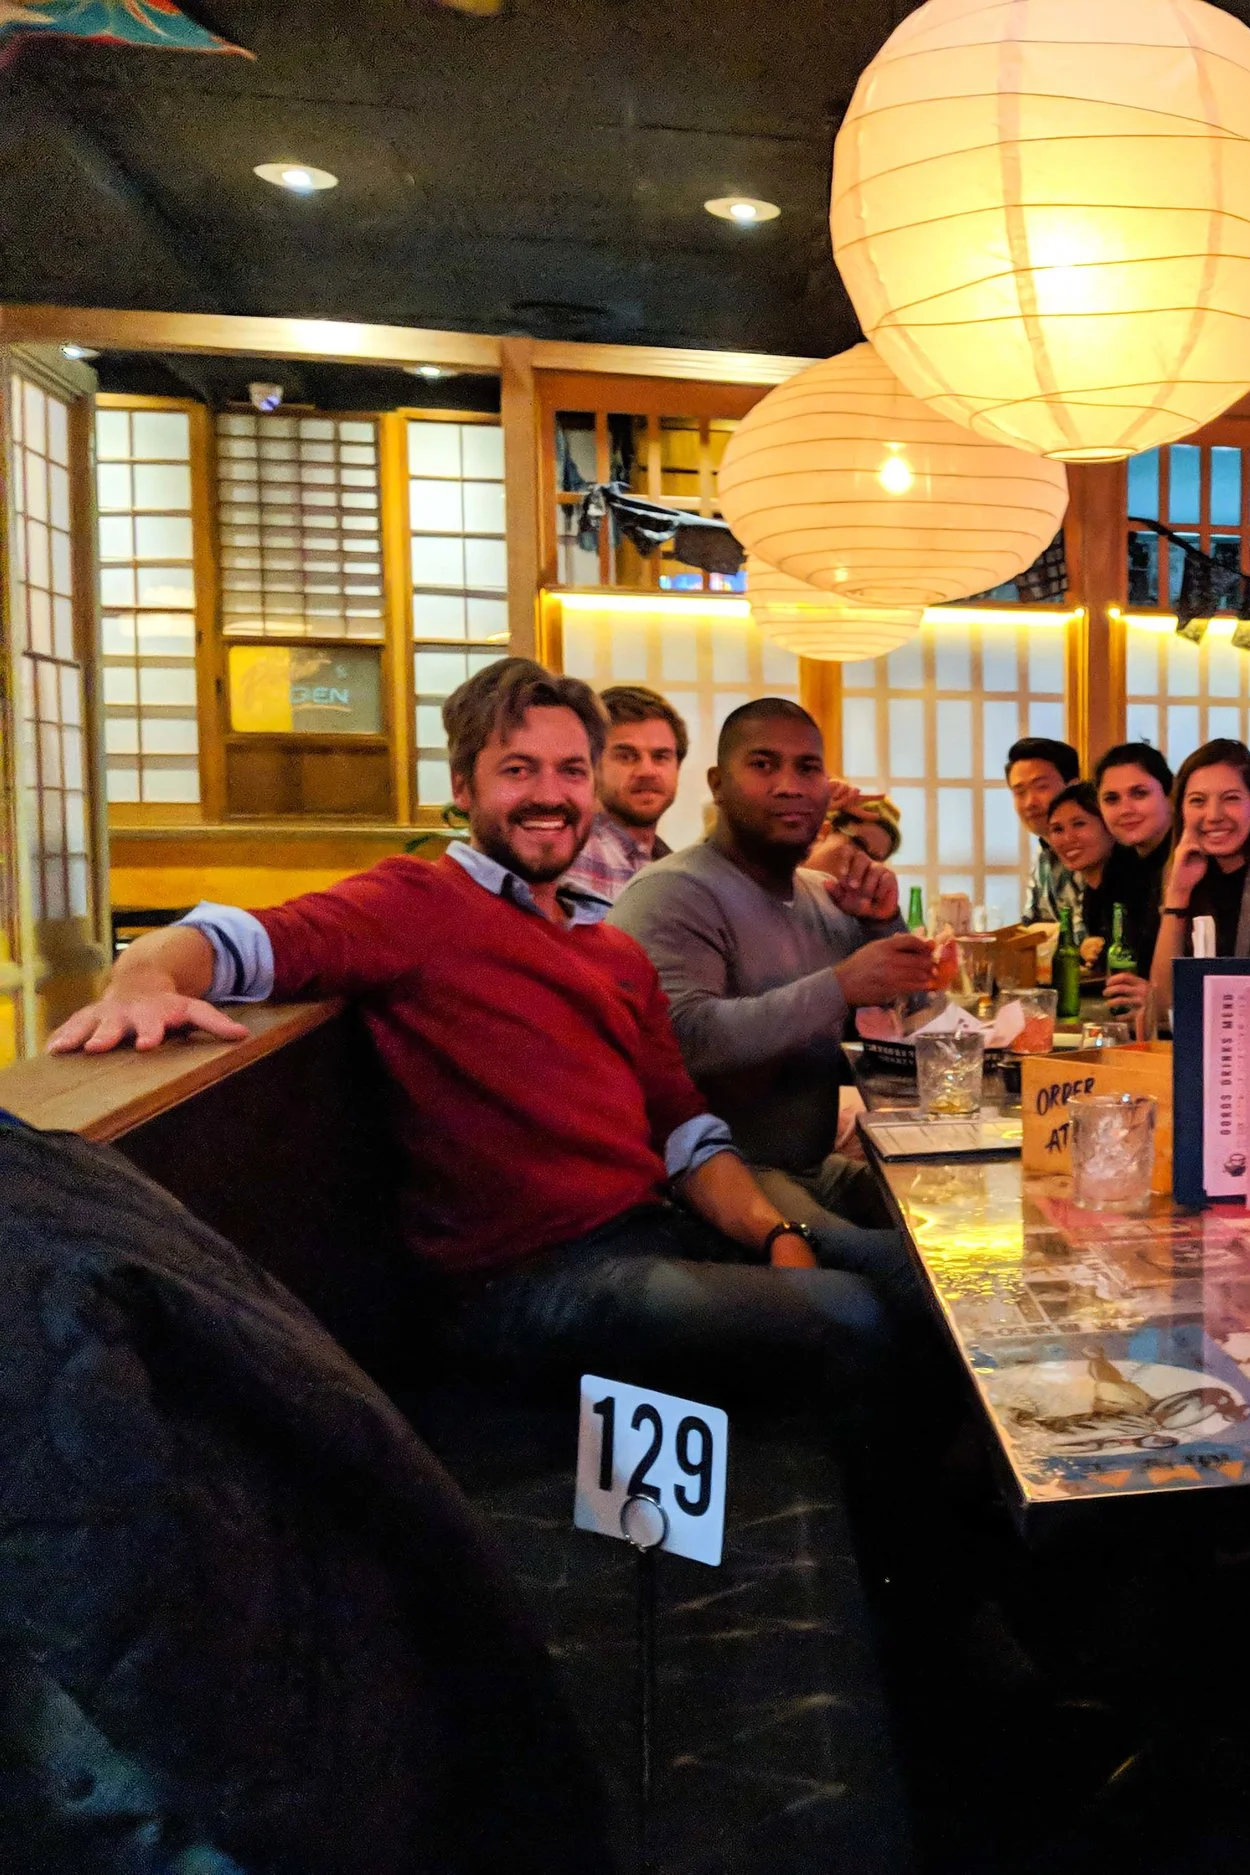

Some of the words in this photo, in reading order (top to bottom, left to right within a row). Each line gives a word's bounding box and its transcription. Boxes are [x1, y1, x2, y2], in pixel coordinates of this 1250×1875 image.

[1220, 994, 1234, 1029] MENU
[1219, 1037, 1233, 1086] DRINKS
[1036, 1077, 1096, 1116] ORDER
[1044, 1122, 1071, 1154] AT
[593, 1395, 713, 1517] 129
